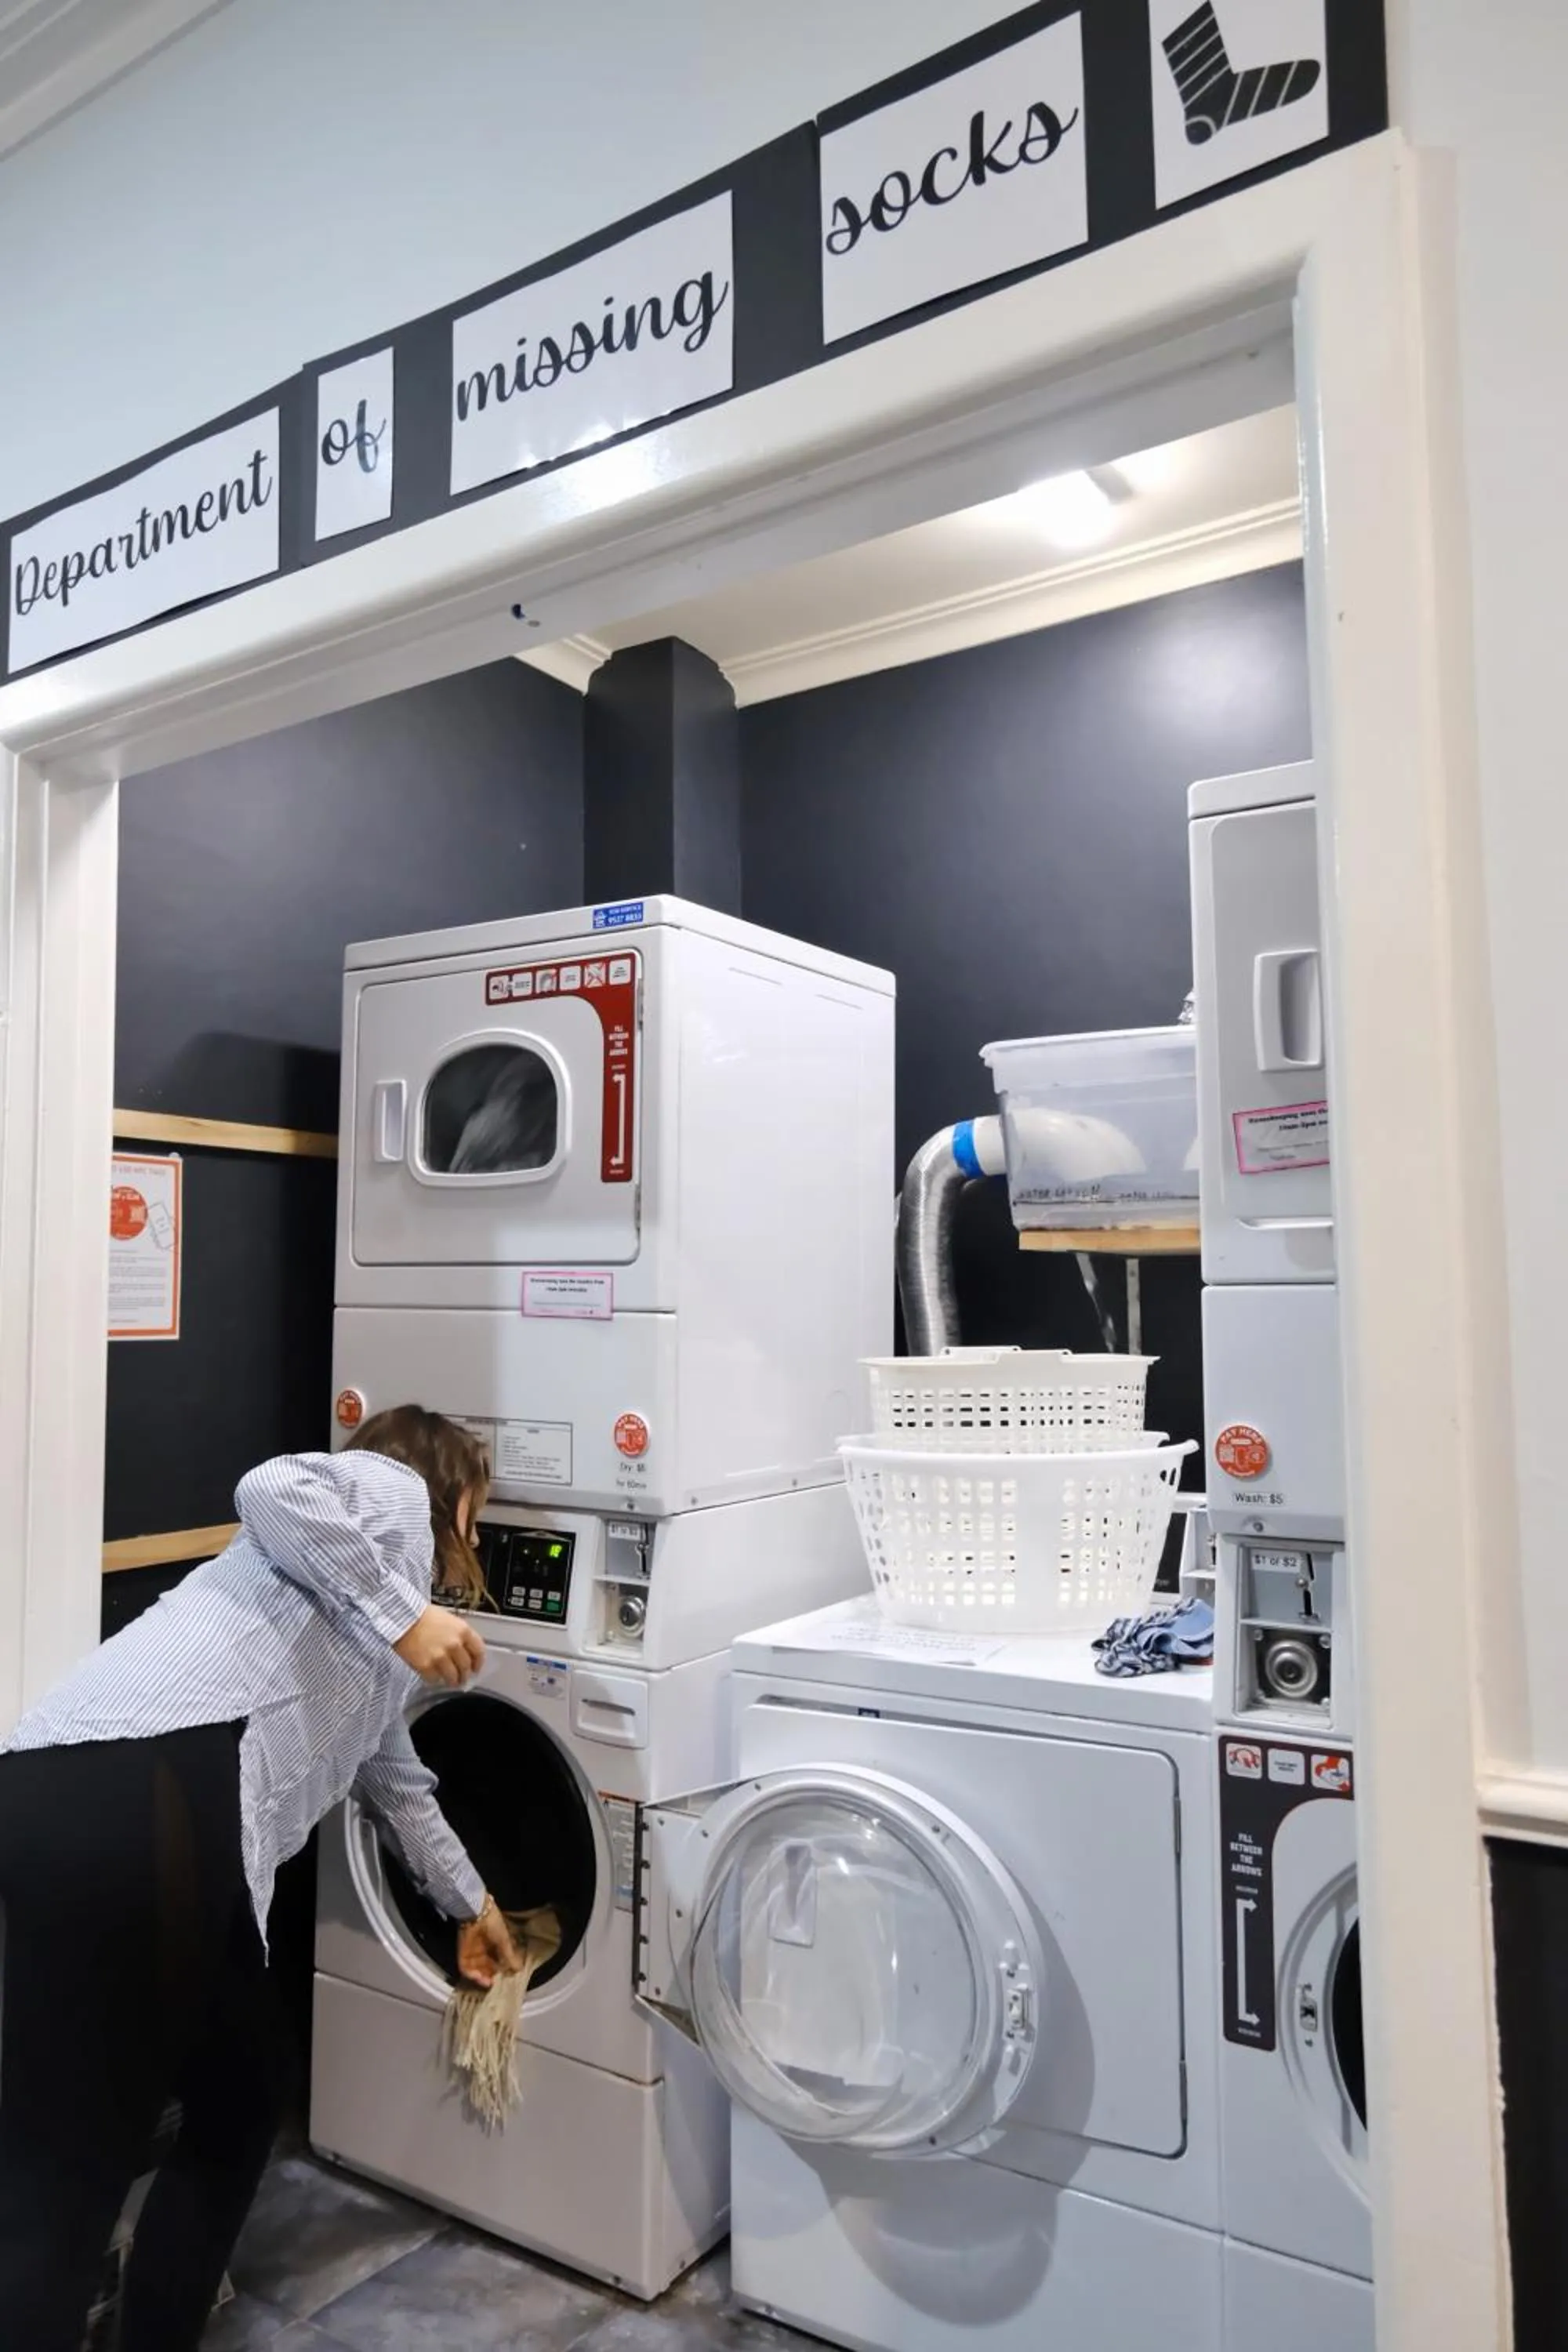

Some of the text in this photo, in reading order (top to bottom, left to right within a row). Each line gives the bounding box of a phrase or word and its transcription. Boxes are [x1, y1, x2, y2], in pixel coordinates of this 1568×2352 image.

[14, 100, 1079, 616] Department of missing socks
[1269, 1493, 1283, 1504] $5
[1282, 1556, 1297, 1567] $2
